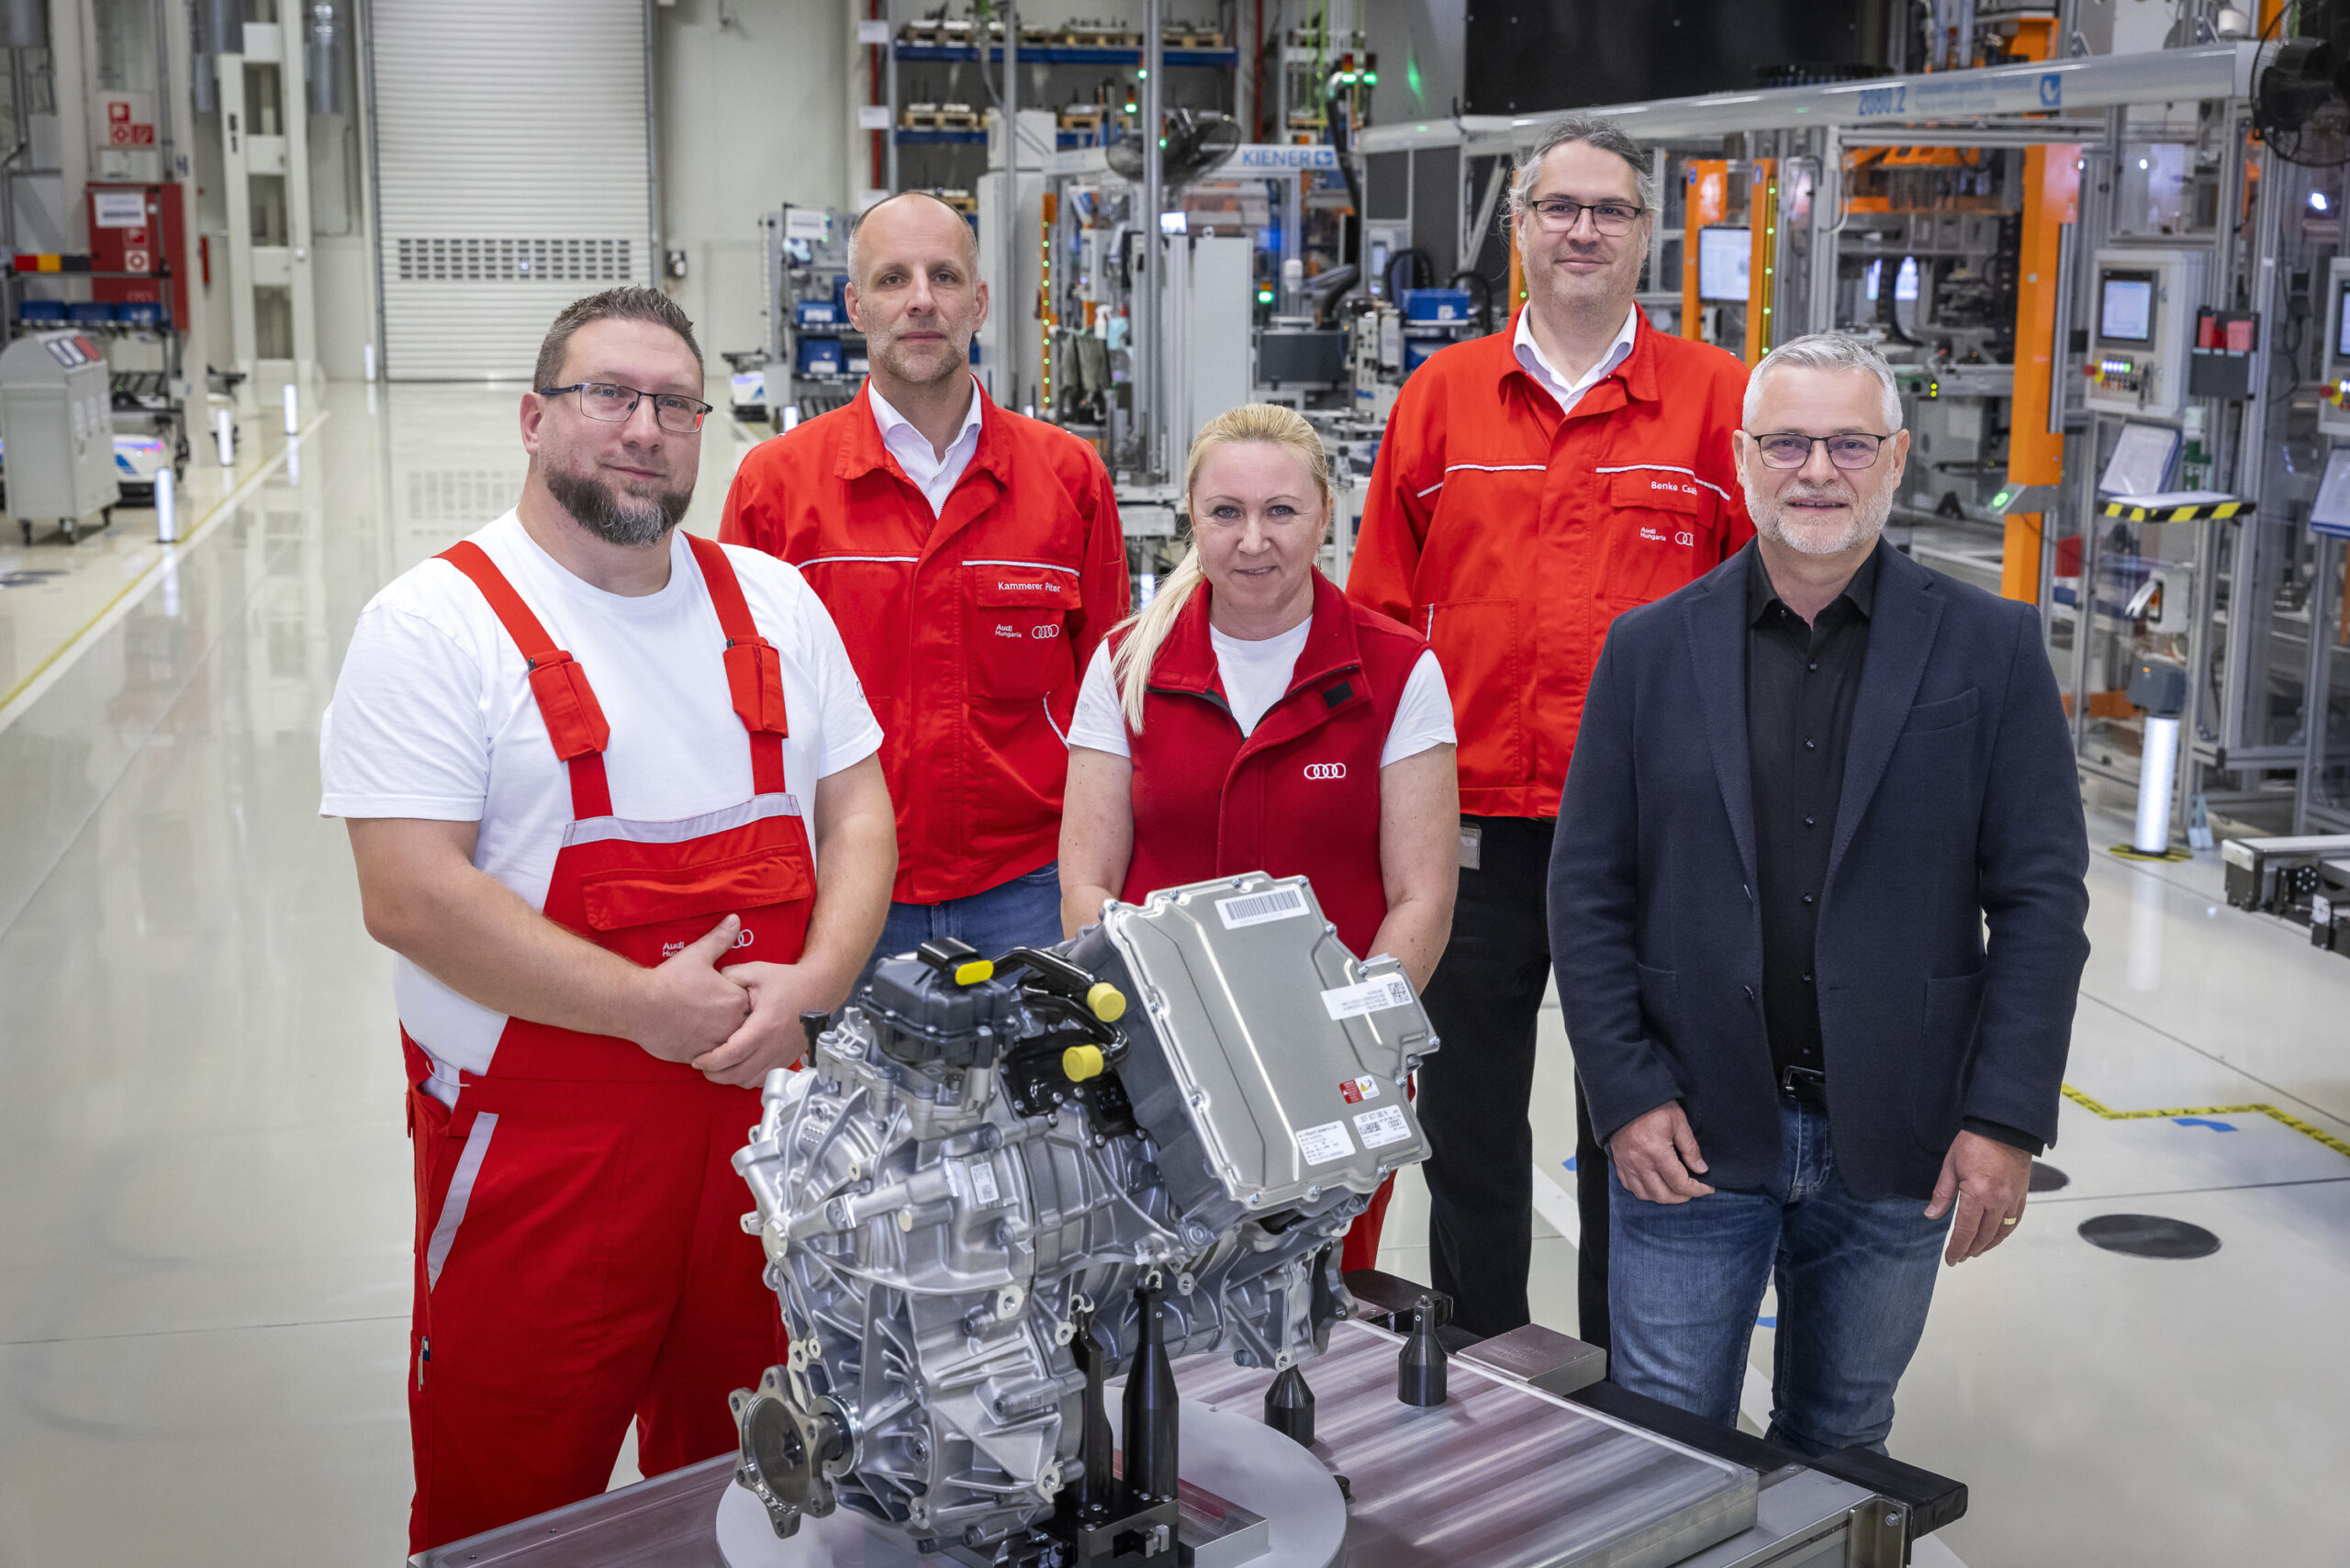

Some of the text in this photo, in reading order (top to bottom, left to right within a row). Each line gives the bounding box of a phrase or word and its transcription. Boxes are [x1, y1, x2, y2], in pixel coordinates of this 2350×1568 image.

[1242, 150, 1311, 166] KIENER
[1651, 481, 1678, 491] Benke
[1640, 526, 1656, 534] Audi
[1639, 532, 1666, 542] Hungaria
[998, 581, 1043, 590] Kammerer
[996, 623, 1013, 632] Audi
[995, 630, 1022, 638] Hungaria
[663, 941, 685, 951] Audi
